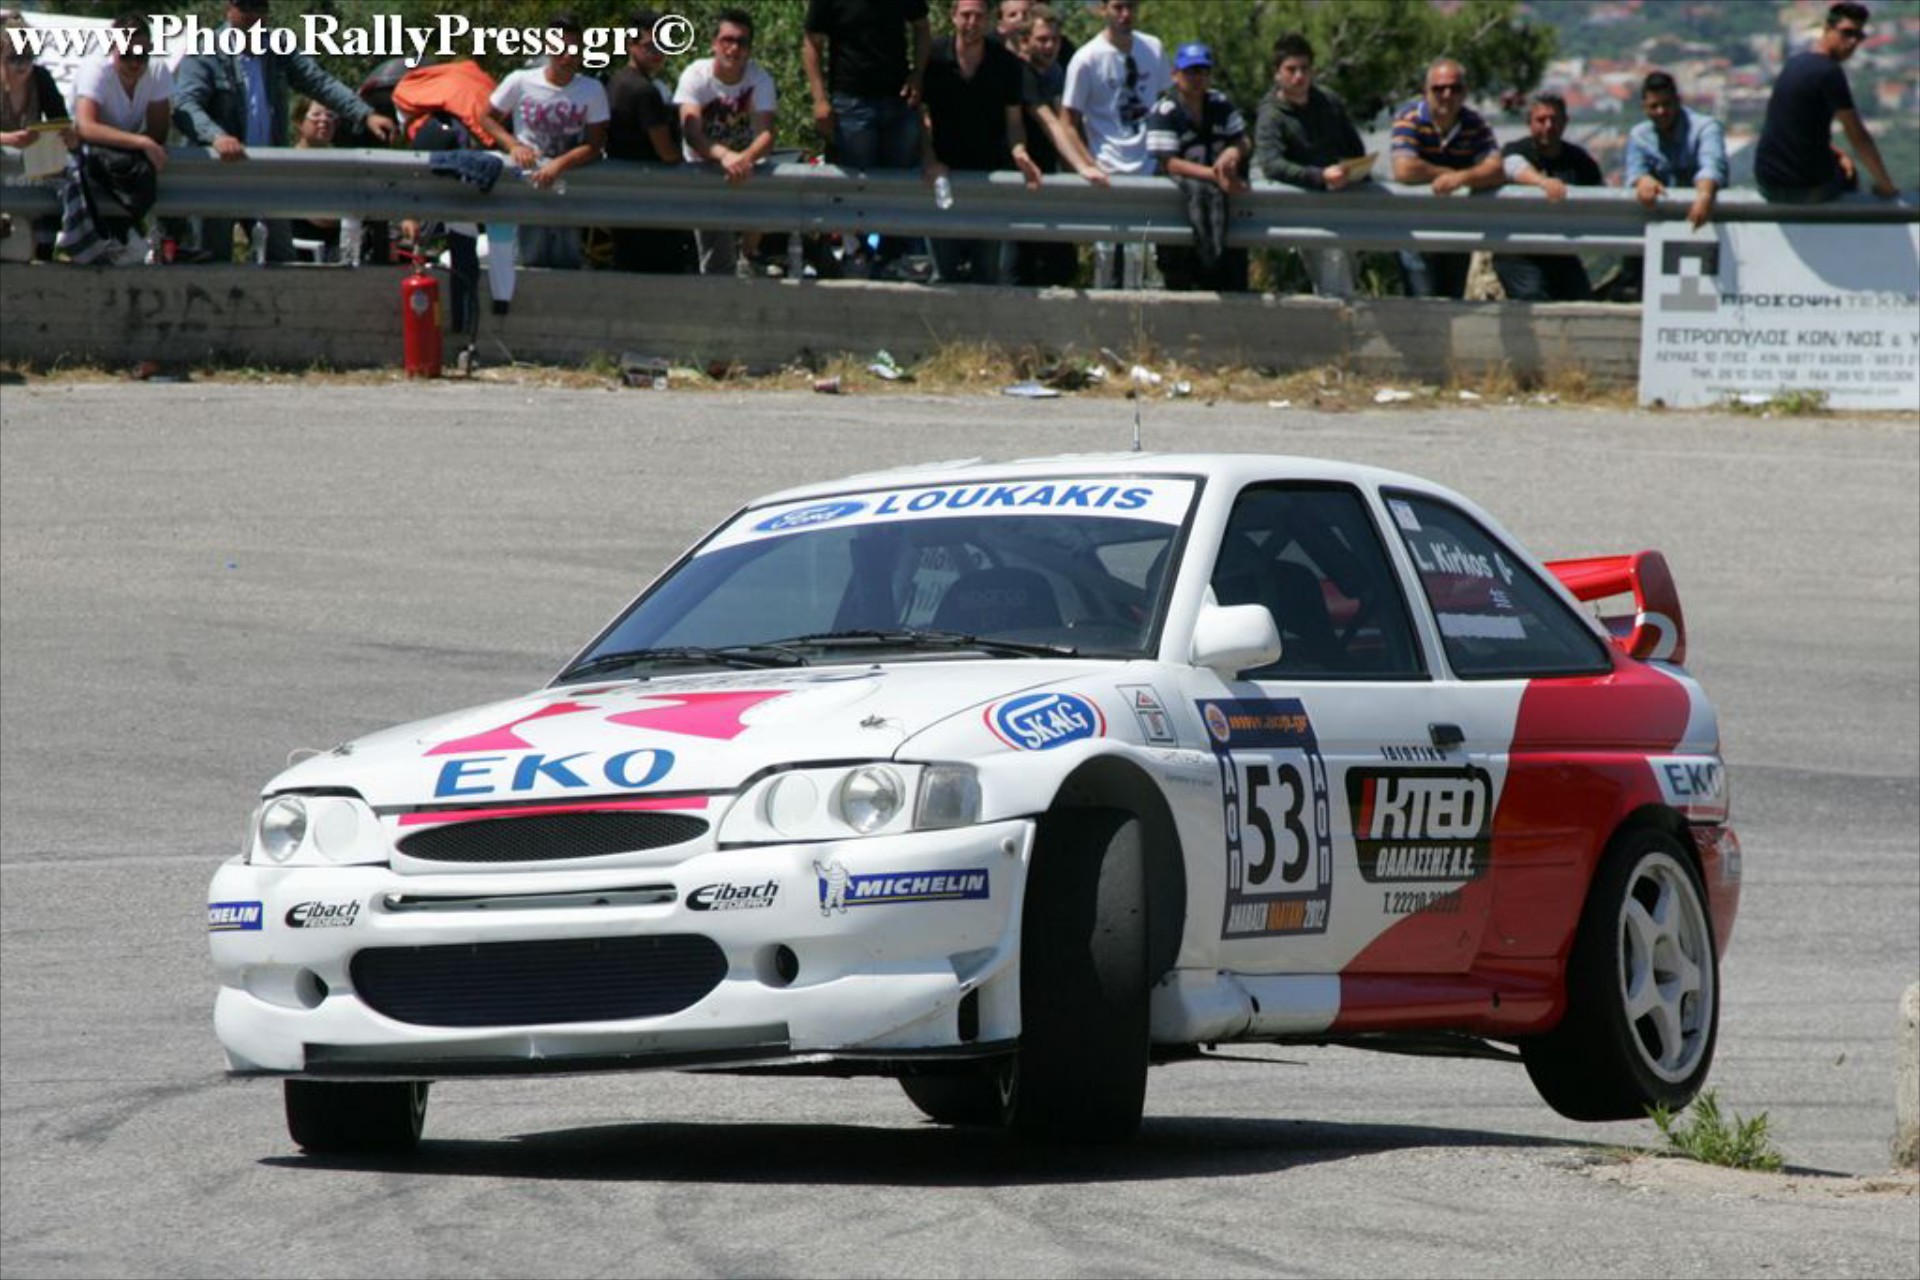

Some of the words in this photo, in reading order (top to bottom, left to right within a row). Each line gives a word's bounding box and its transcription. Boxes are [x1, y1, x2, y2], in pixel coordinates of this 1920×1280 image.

[1657, 328, 1789, 346] ΠΕΤΡΟΠΟΥΛΟΣ
[872, 484, 1156, 516] LOUKAKIS
[1430, 541, 1494, 579] Kirkos
[433, 748, 677, 798] EKO
[1246, 762, 1310, 885] 53
[685, 879, 780, 912] Eibach
[853, 872, 986, 898] MICHELIN
[284, 899, 361, 928] Eibach
